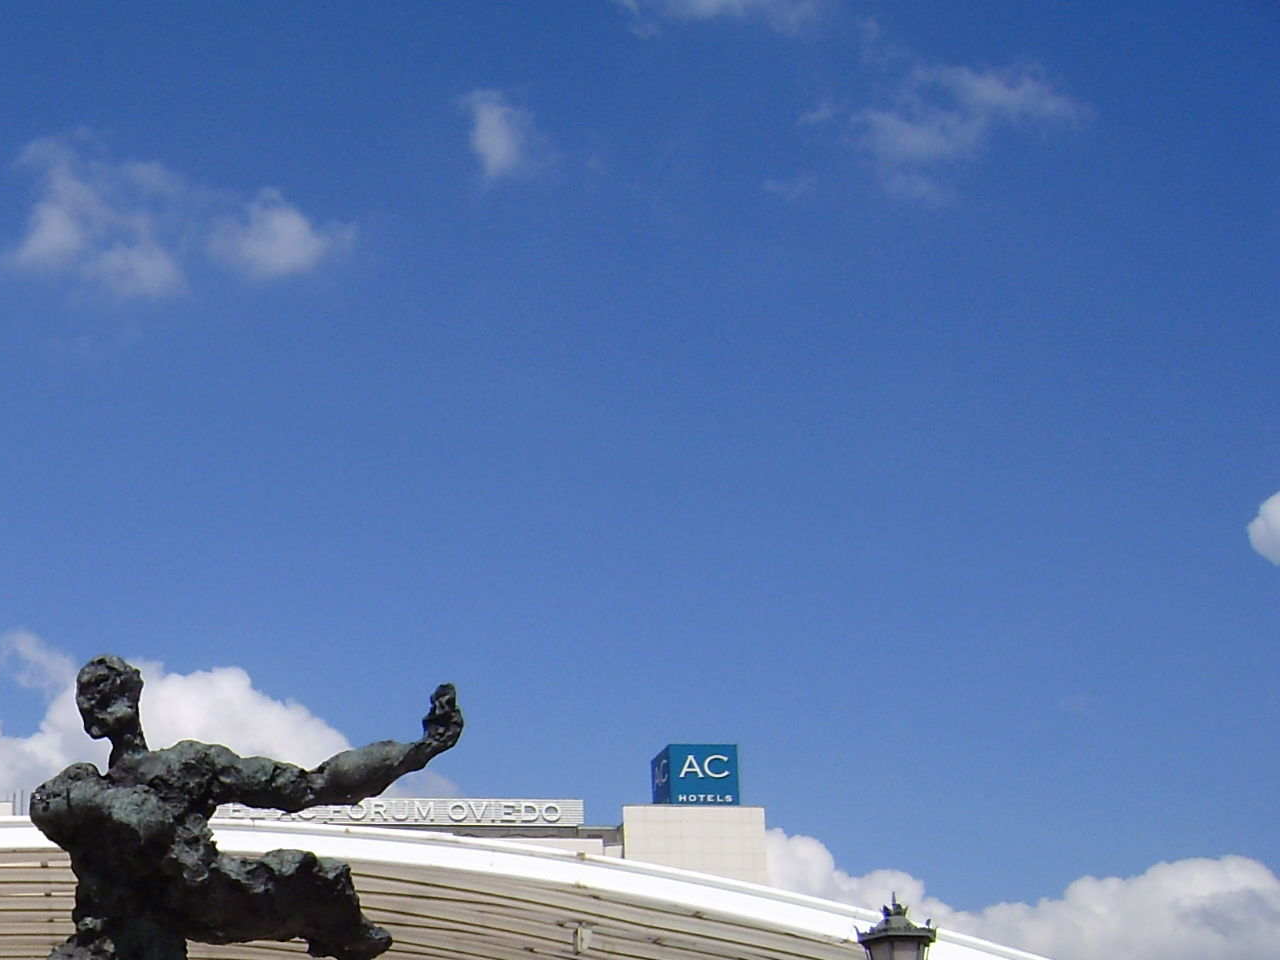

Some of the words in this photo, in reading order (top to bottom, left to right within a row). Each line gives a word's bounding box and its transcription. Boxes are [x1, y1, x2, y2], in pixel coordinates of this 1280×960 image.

[678, 754, 730, 778] AC
[677, 794, 733, 803] HOTELS
[330, 801, 435, 822] FORUM
[448, 802, 562, 823] OVIEDO
